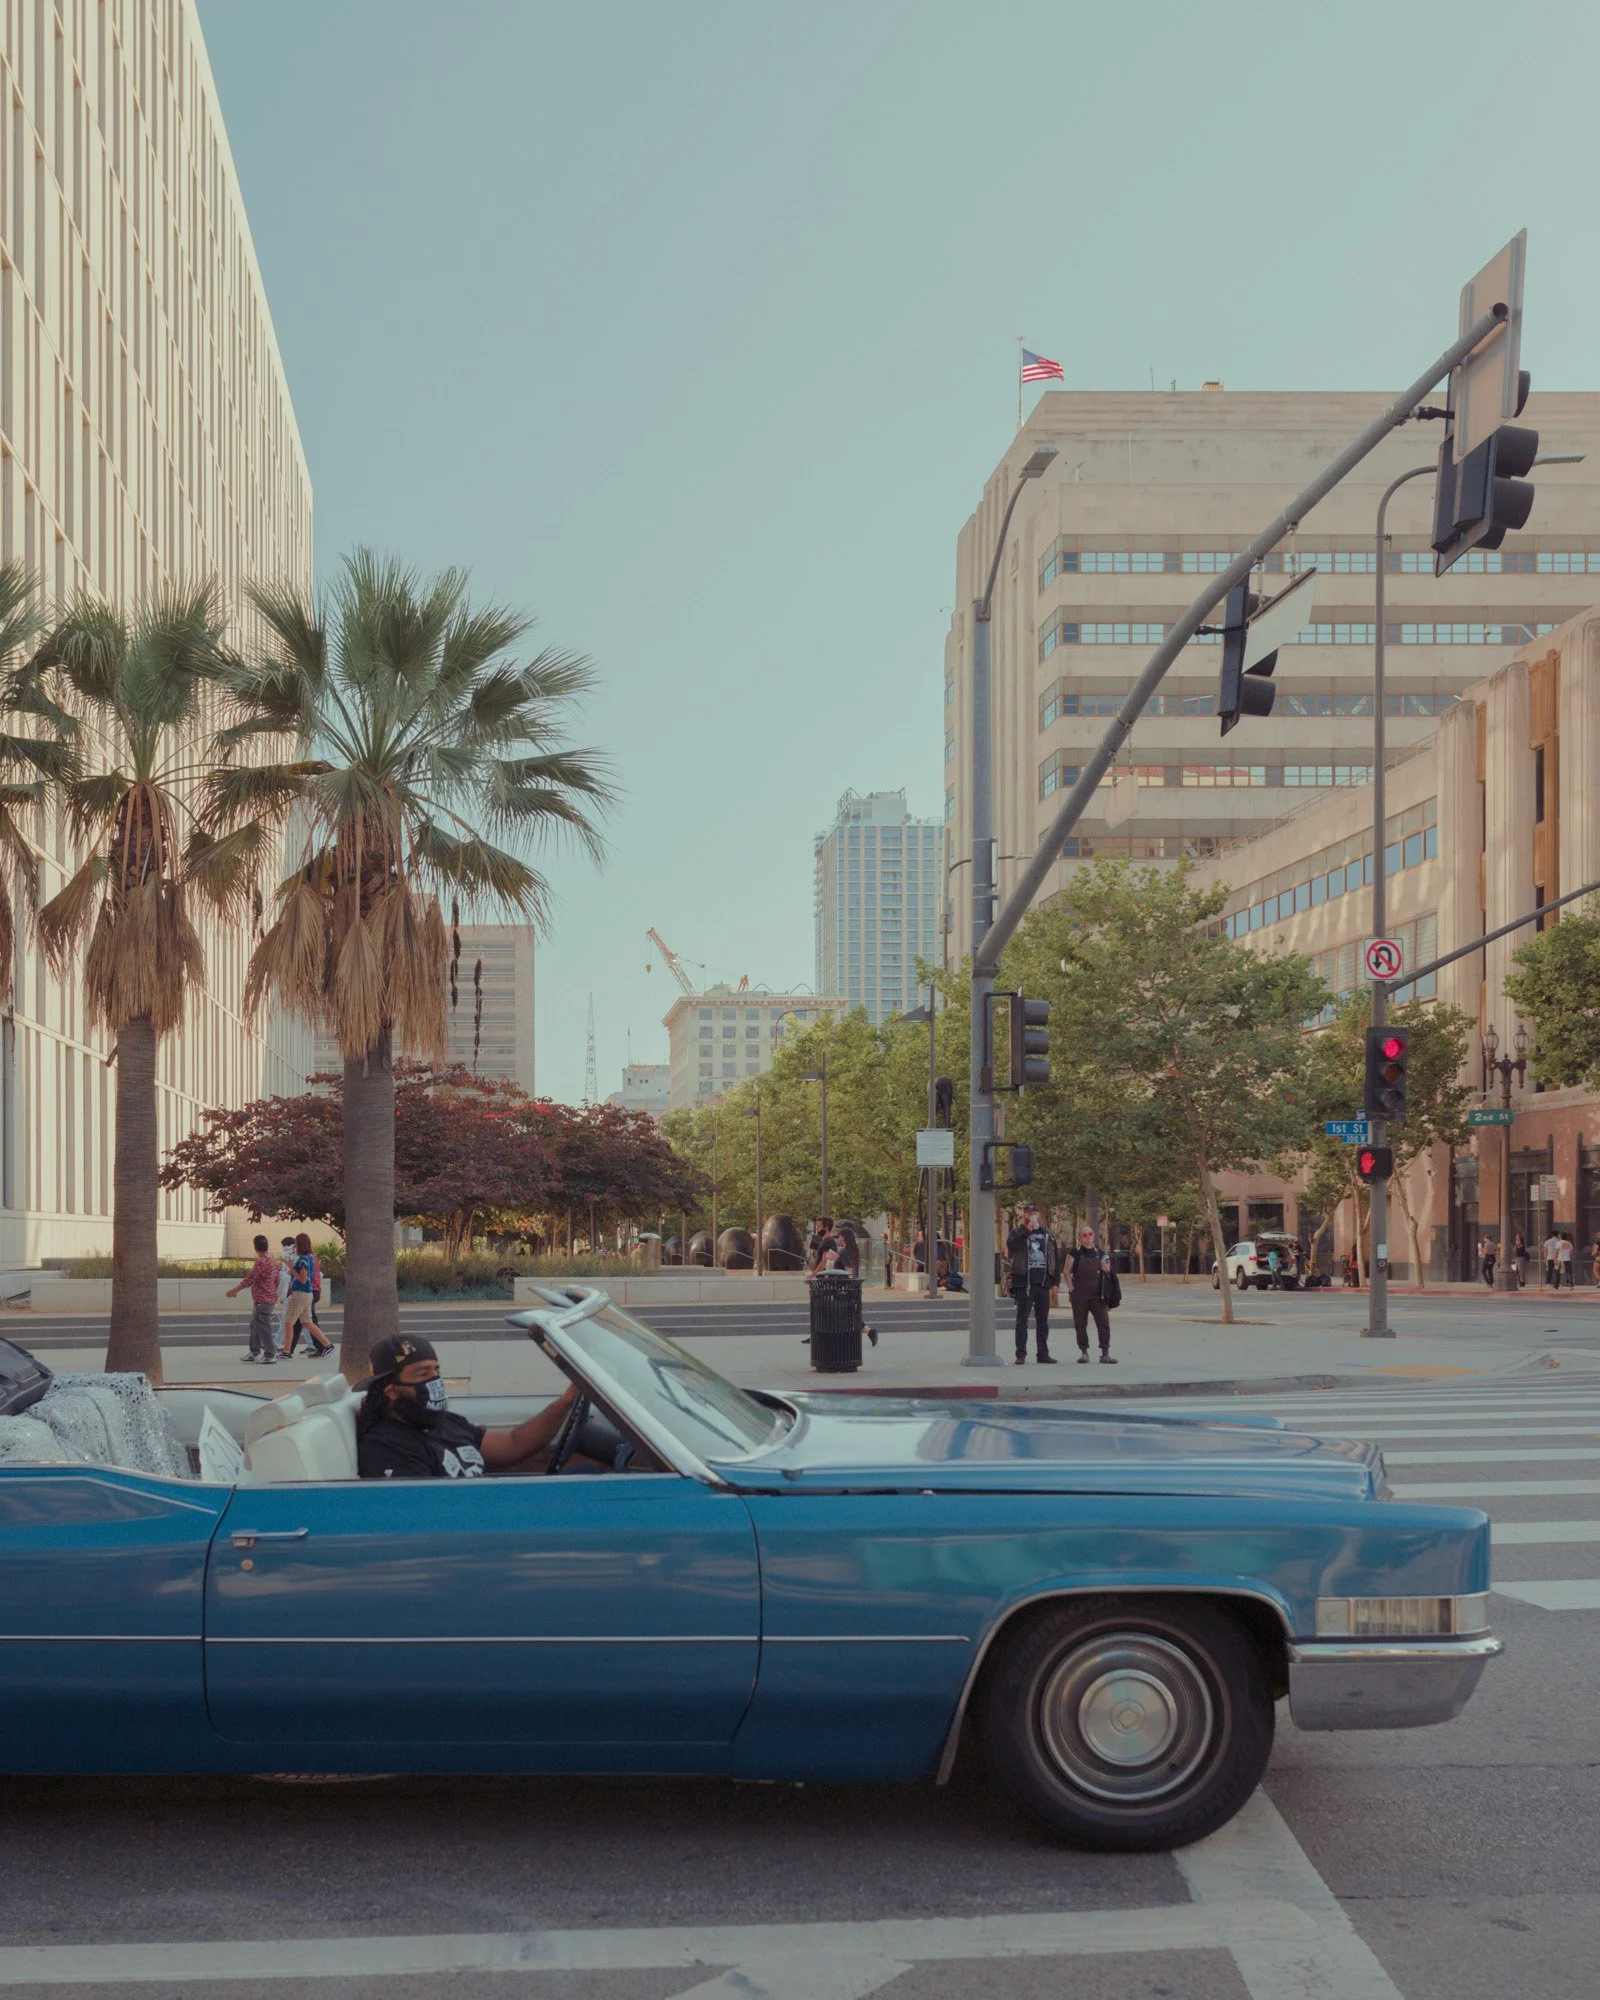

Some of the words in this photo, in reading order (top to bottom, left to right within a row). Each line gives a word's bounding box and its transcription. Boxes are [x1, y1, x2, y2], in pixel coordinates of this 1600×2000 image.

[1474, 1113, 1493, 1121] 2nd
[1332, 1123, 1347, 1133] 1st
[1353, 1123, 1363, 1133] St
